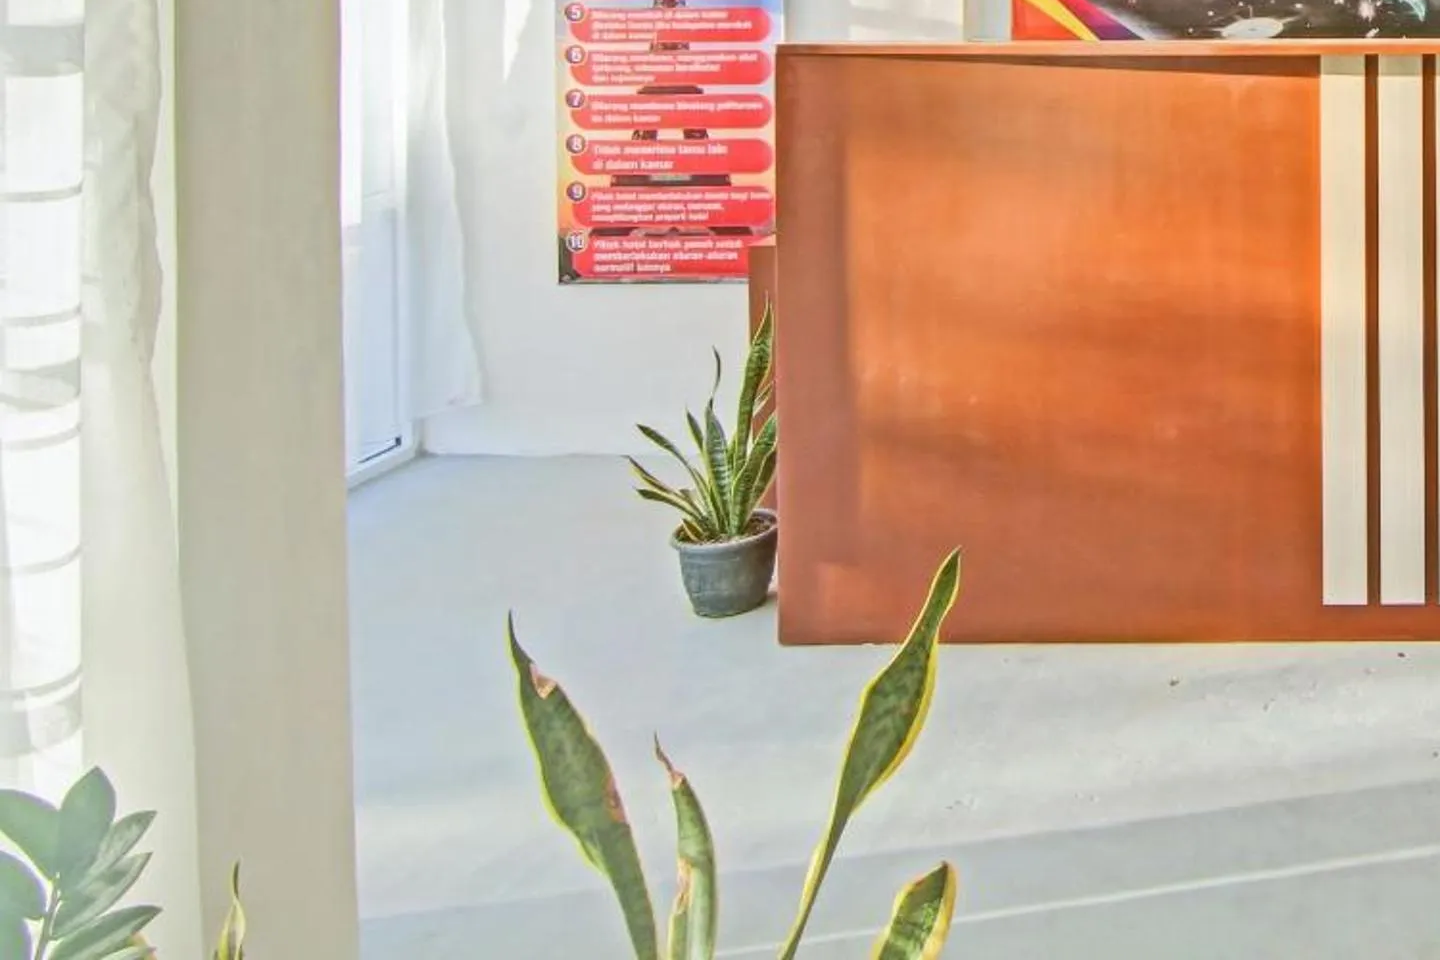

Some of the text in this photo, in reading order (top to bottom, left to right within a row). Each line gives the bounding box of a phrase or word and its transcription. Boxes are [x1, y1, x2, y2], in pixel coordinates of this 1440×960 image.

[571, 7, 581, 20] 5
[571, 51, 581, 64] 6
[572, 93, 581, 107] 7
[572, 139, 581, 152] 8
[573, 186, 582, 199] 9
[571, 237, 584, 250] 10
